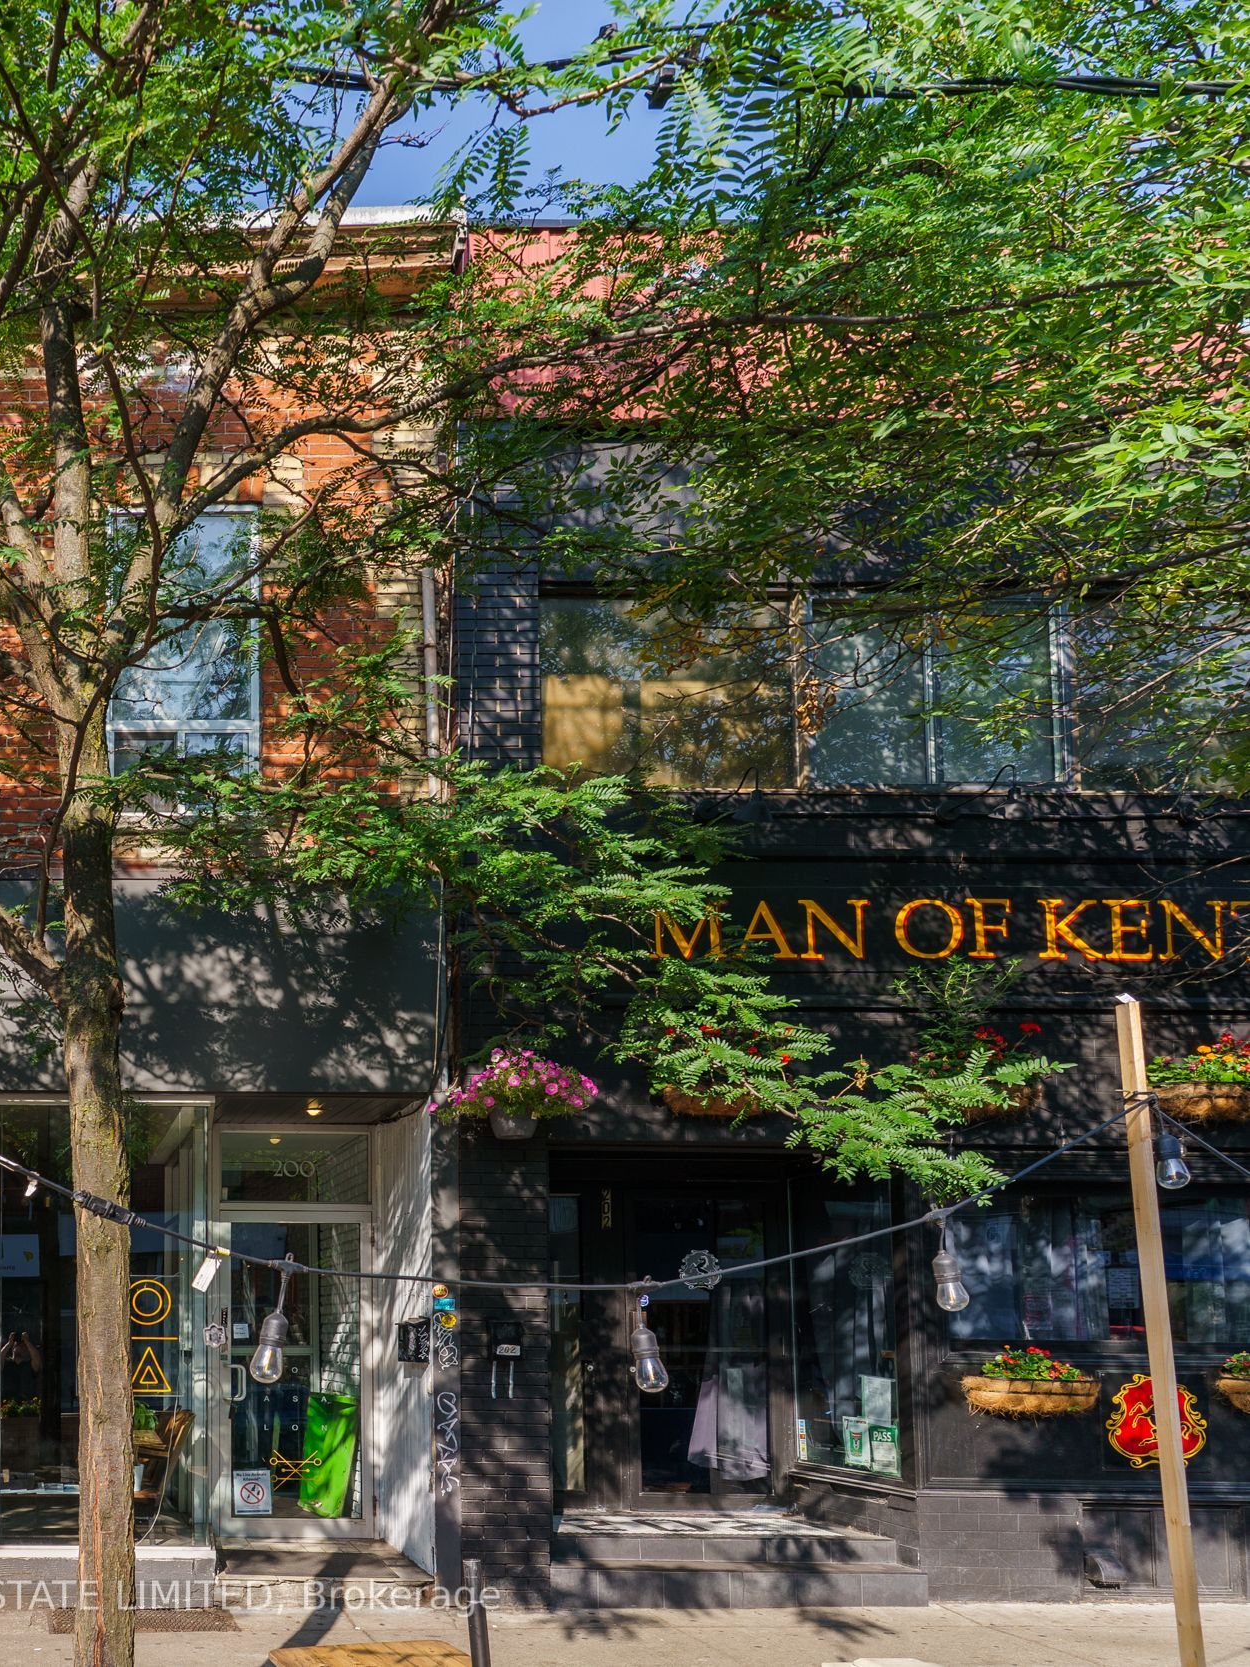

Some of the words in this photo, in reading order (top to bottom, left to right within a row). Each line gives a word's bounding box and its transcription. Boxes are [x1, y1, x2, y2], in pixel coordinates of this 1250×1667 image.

[649, 898, 871, 961] MAN
[893, 897, 1012, 961] OF
[273, 1159, 316, 1178] 200
[498, 1346, 517, 1354] 202
[873, 1431, 892, 1442] PASS
[561, 1517, 783, 1533] 202
